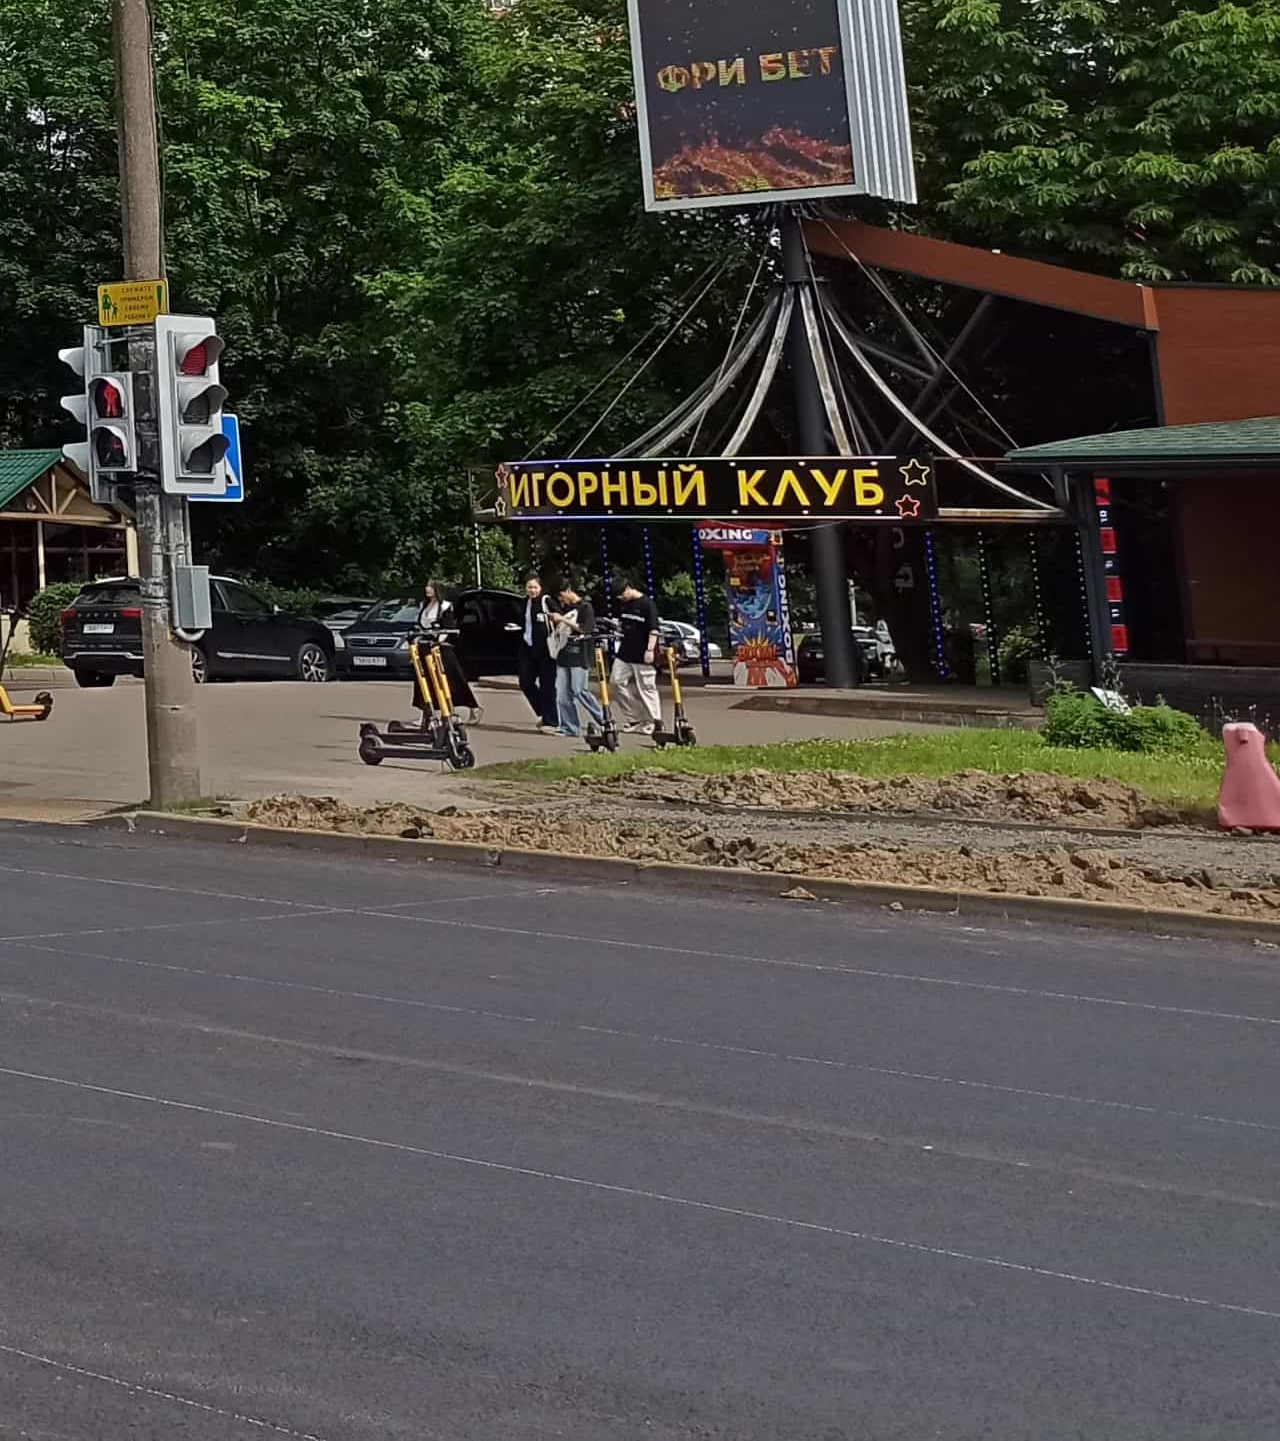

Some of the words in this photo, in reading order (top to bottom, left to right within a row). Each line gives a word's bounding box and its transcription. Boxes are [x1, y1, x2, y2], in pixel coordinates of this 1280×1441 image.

[657, 58, 746, 93] ФРИ
[759, 46, 837, 81] БЕТ
[509, 464, 708, 507] ИГОРНЫЙ
[738, 469, 885, 507] КЛУБ
[778, 573, 794, 664] BOXING
